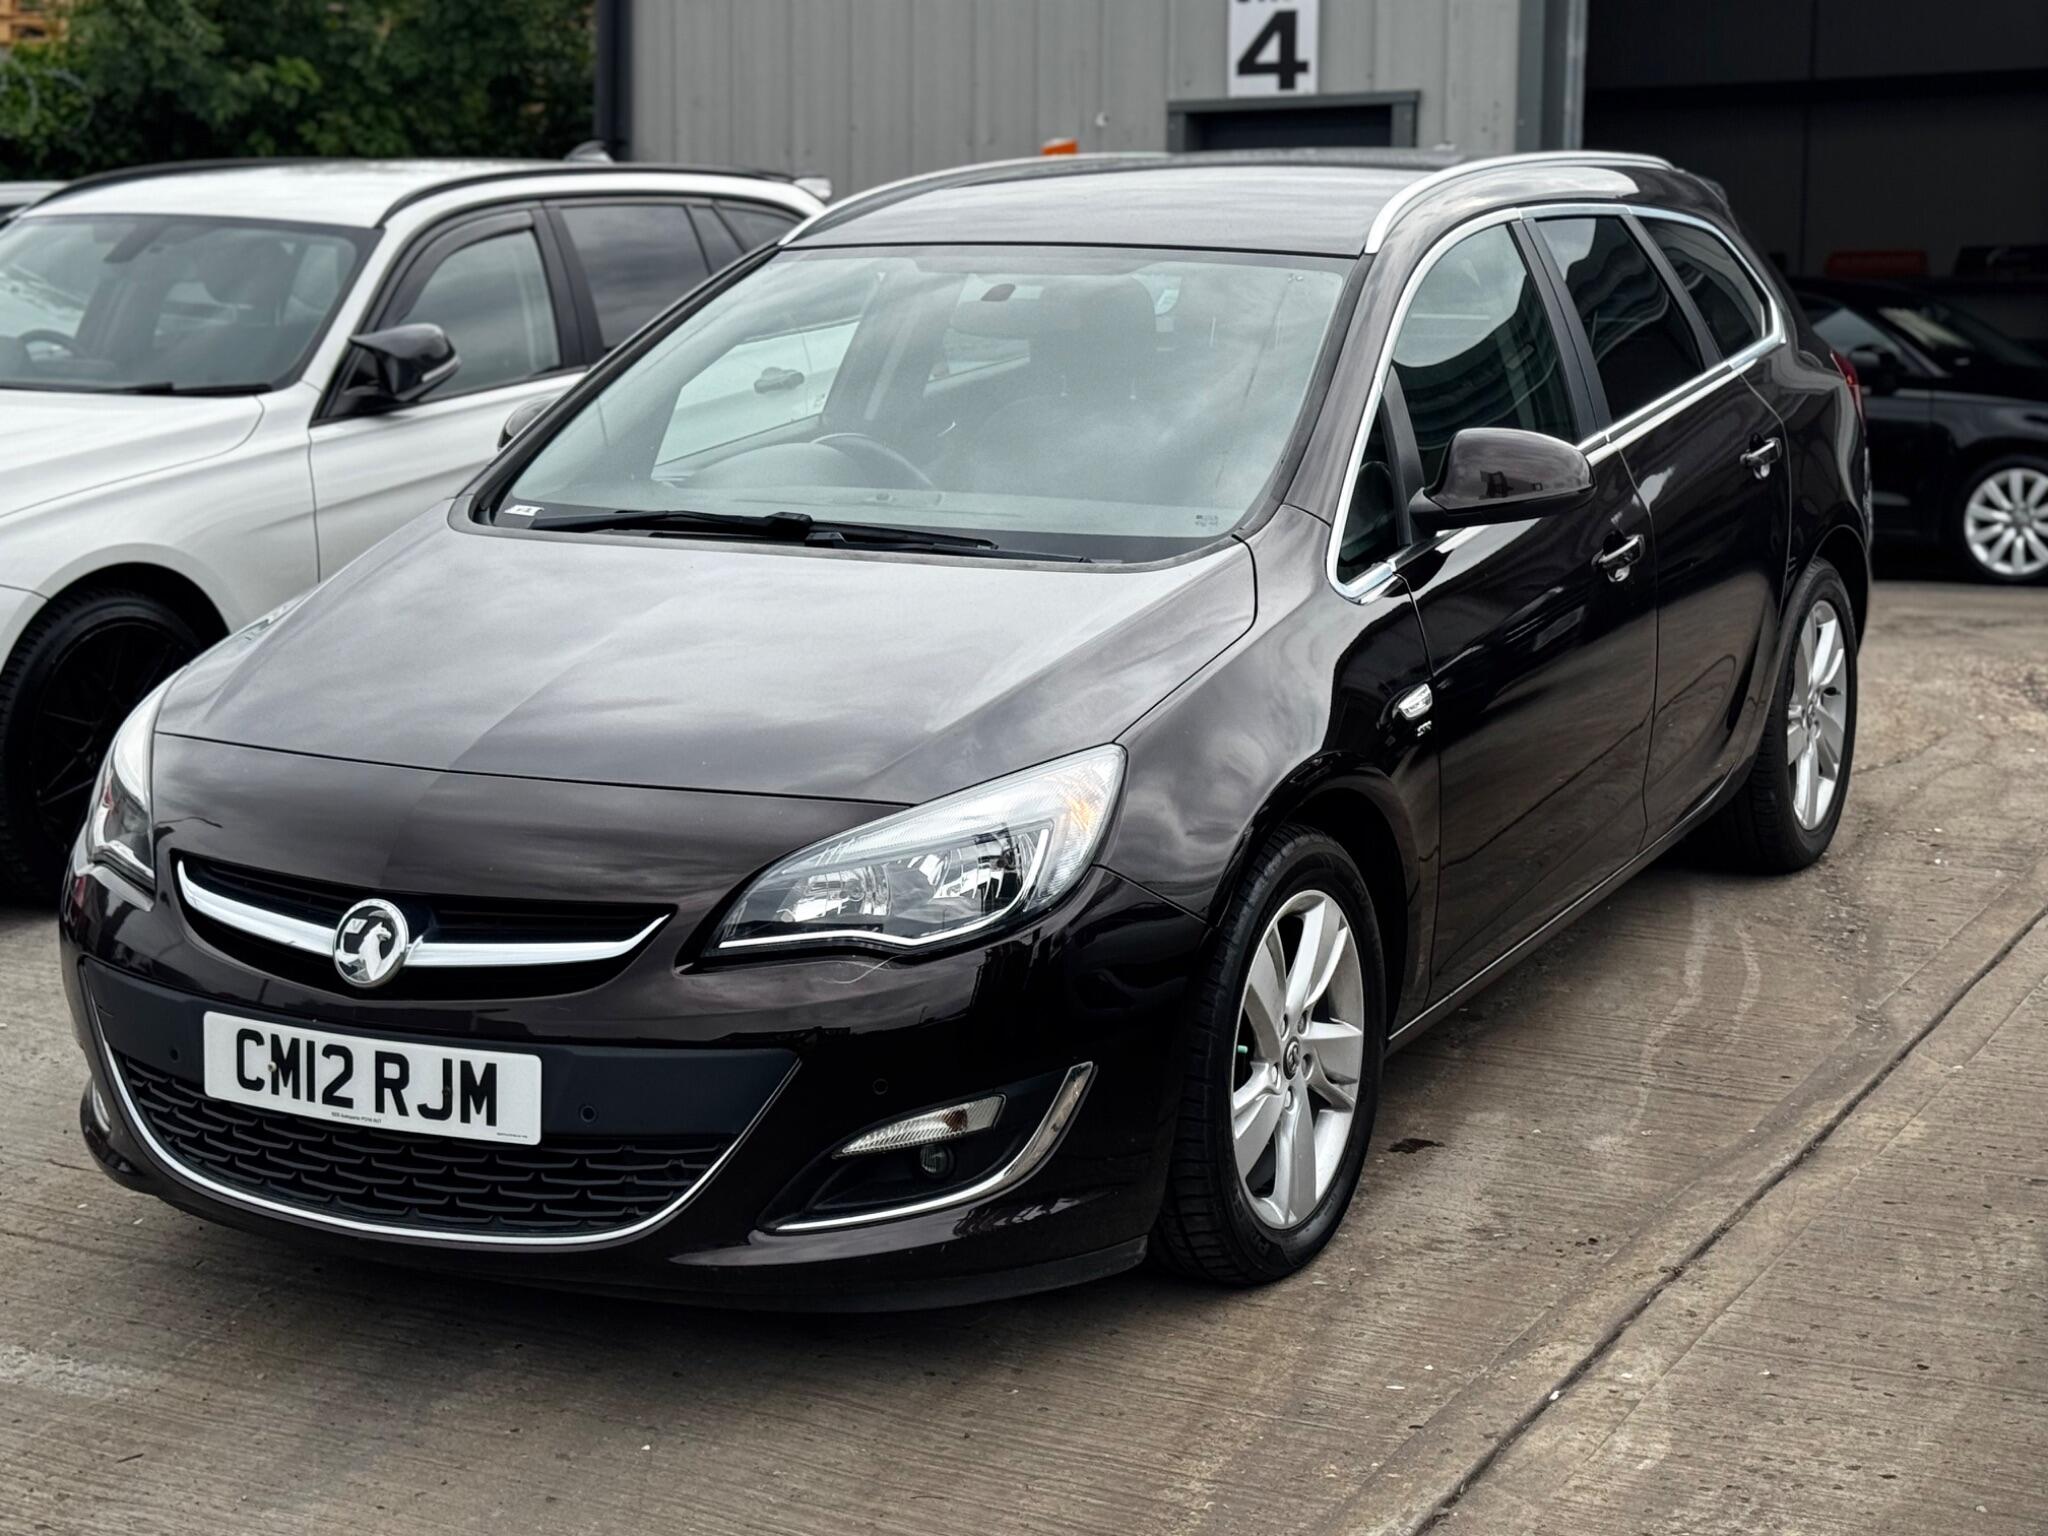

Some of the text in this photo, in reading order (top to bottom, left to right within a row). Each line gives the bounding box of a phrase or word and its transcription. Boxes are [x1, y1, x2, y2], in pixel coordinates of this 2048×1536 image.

[1236, 9, 1309, 91] 4
[236, 1028, 497, 1127] CM12 RJM
